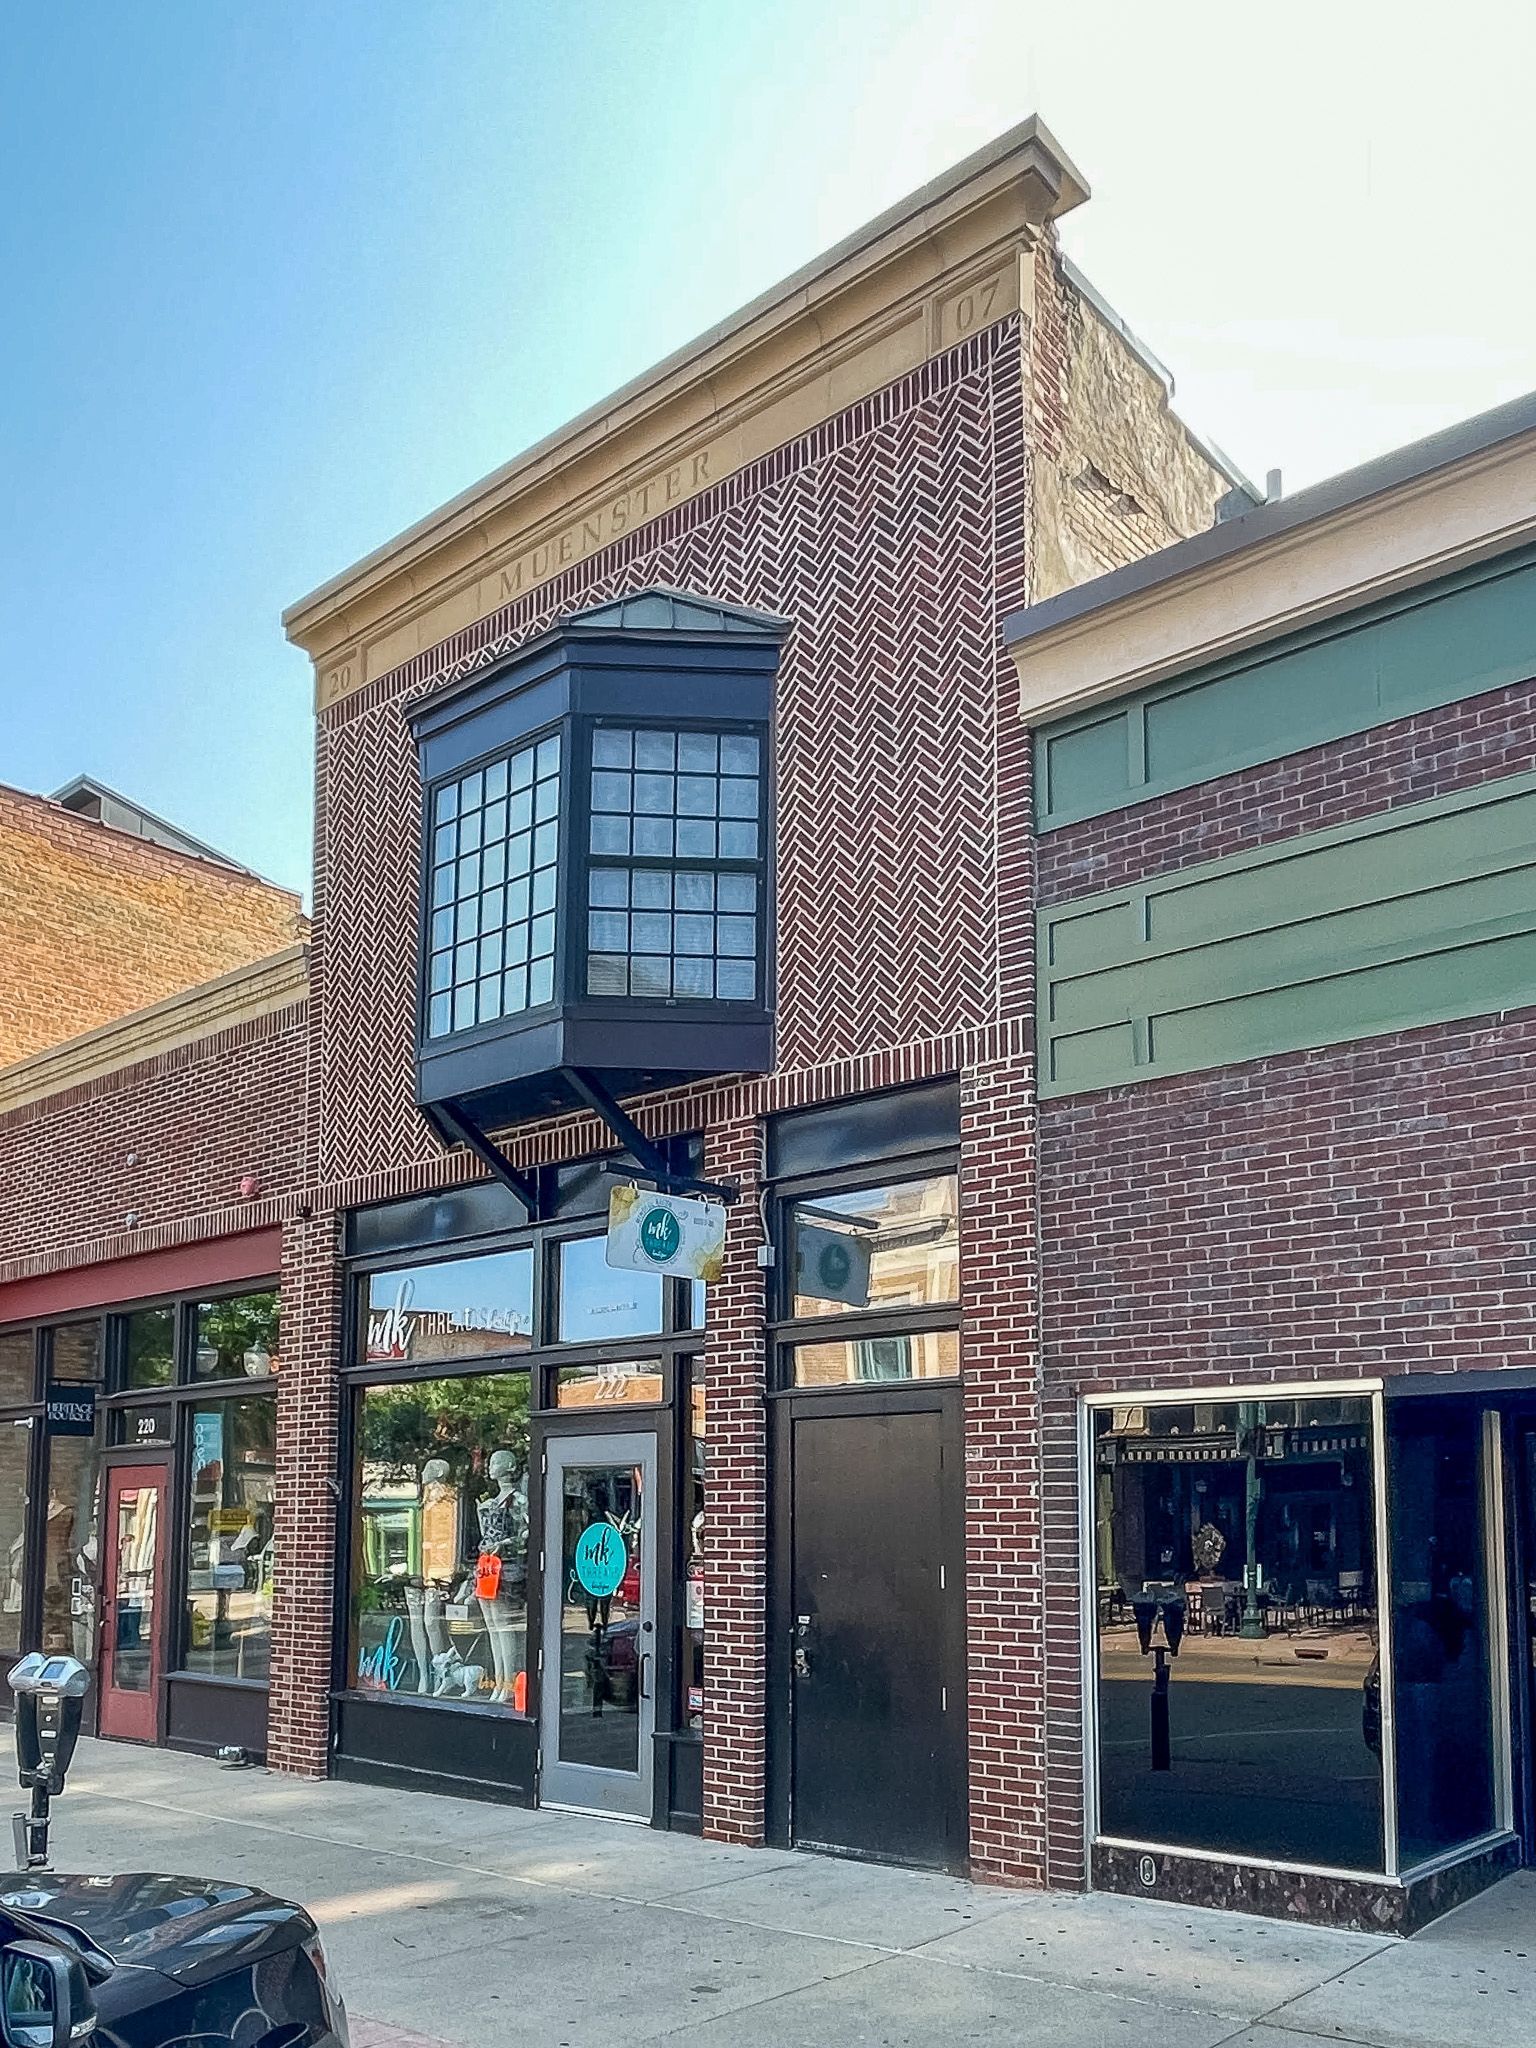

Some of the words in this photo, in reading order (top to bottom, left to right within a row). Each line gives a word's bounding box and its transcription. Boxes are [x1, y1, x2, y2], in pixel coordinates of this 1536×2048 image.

[956, 278, 1000, 332] 07
[500, 451, 710, 600] MUENSTER
[329, 665, 351, 698] 20
[593, 1373, 628, 1400] 222
[47, 1402, 94, 1413] HERITAGE
[137, 1418, 155, 1435] 220
